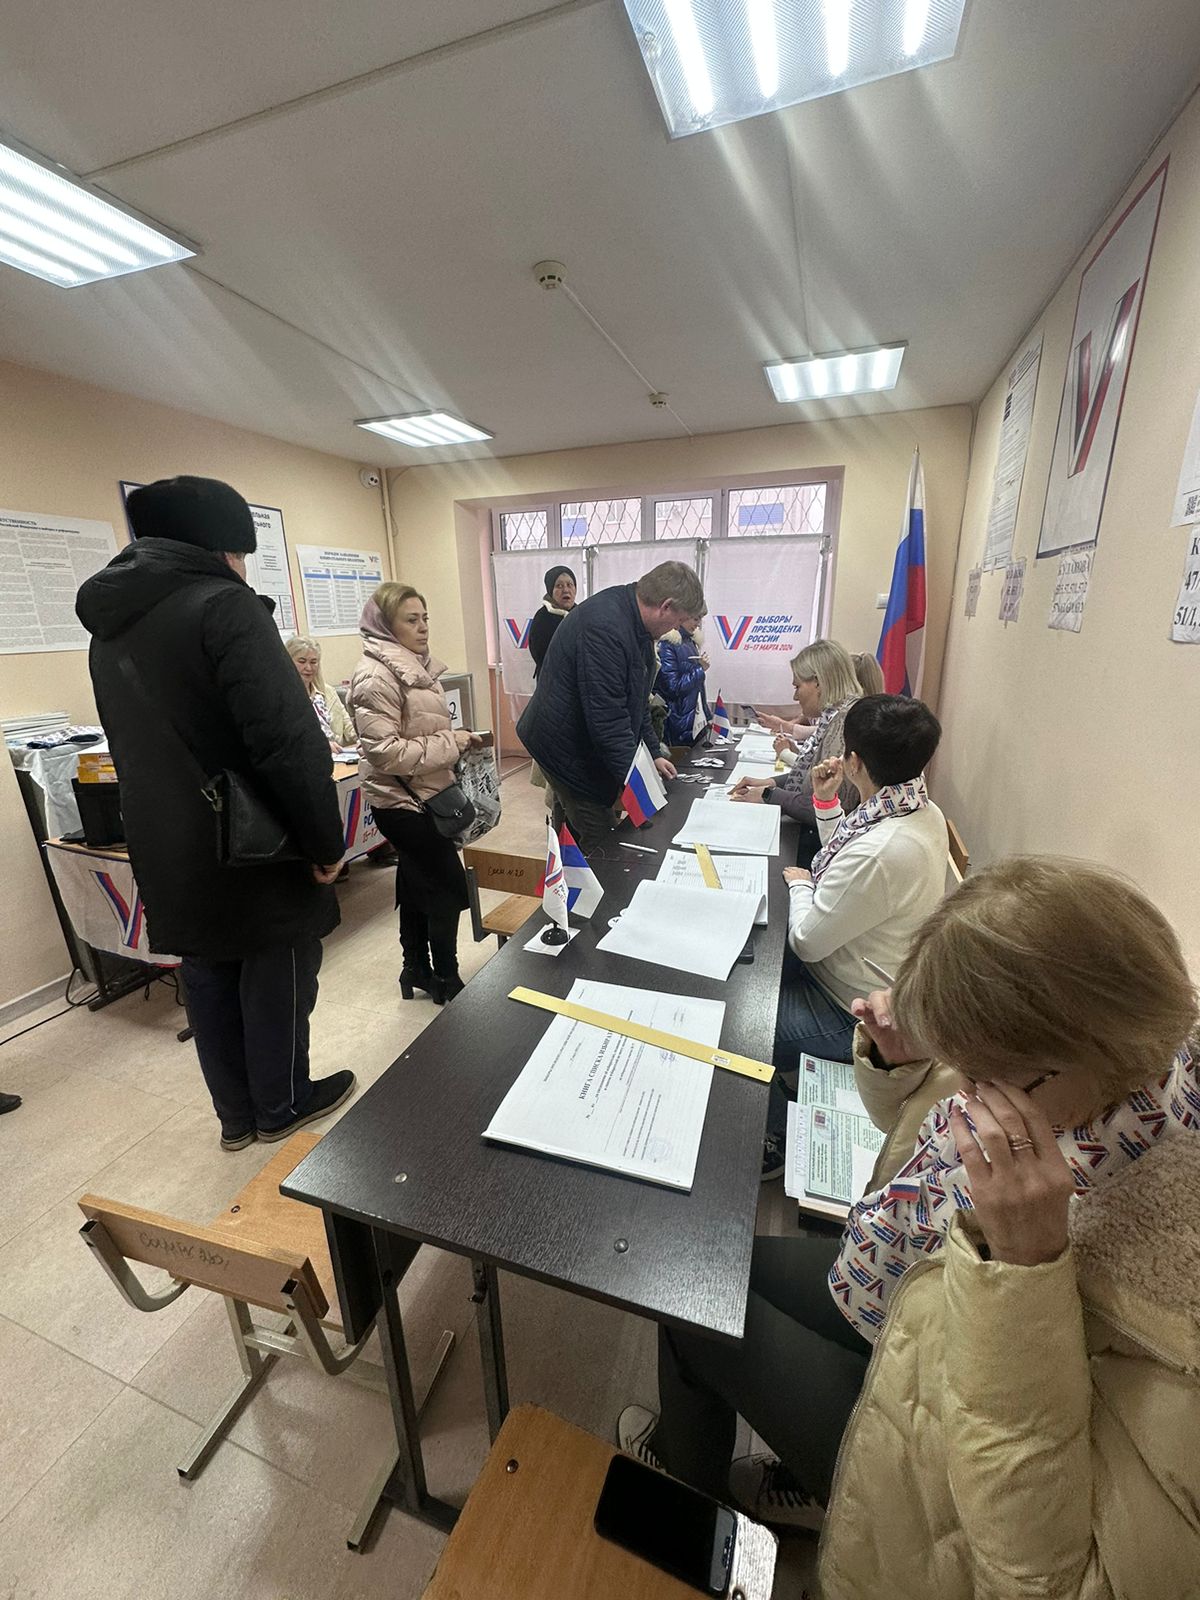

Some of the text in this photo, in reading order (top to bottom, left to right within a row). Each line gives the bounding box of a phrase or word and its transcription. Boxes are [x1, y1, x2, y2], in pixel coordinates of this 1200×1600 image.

[756, 615, 792, 624] ВЫБОРЫ
[751, 625, 802, 634] ПРЕЗИДЕНТА
[746, 635, 780, 643] РОССИИ
